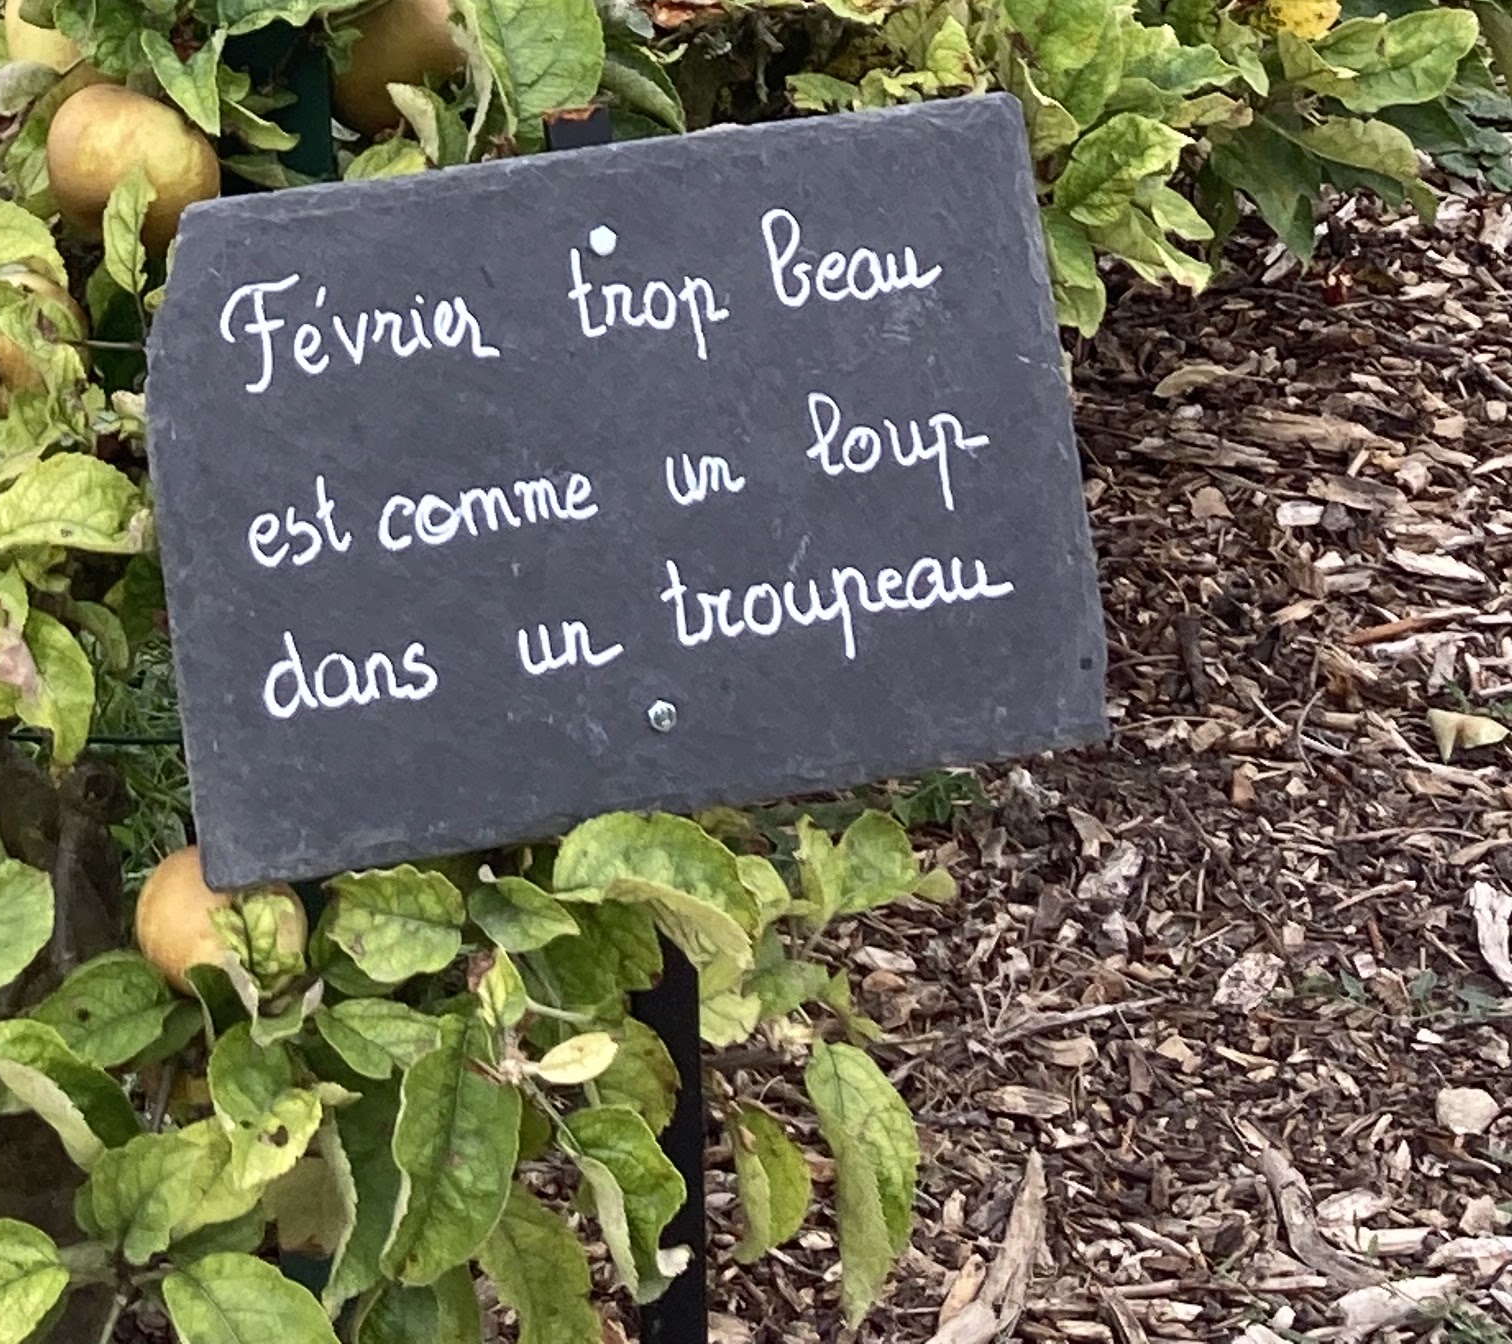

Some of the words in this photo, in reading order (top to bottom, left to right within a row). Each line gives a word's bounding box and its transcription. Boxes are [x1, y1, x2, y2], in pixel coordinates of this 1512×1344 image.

[218, 272, 502, 395] Février
[566, 244, 731, 362] trop
[760, 207, 944, 309] beau
[247, 474, 354, 569] est
[376, 472, 600, 553] comme
[664, 452, 747, 508] un
[804, 391, 991, 512] loup
[261, 629, 439, 720] dans
[516, 620, 625, 677] un
[658, 555, 1016, 661] troupeau
